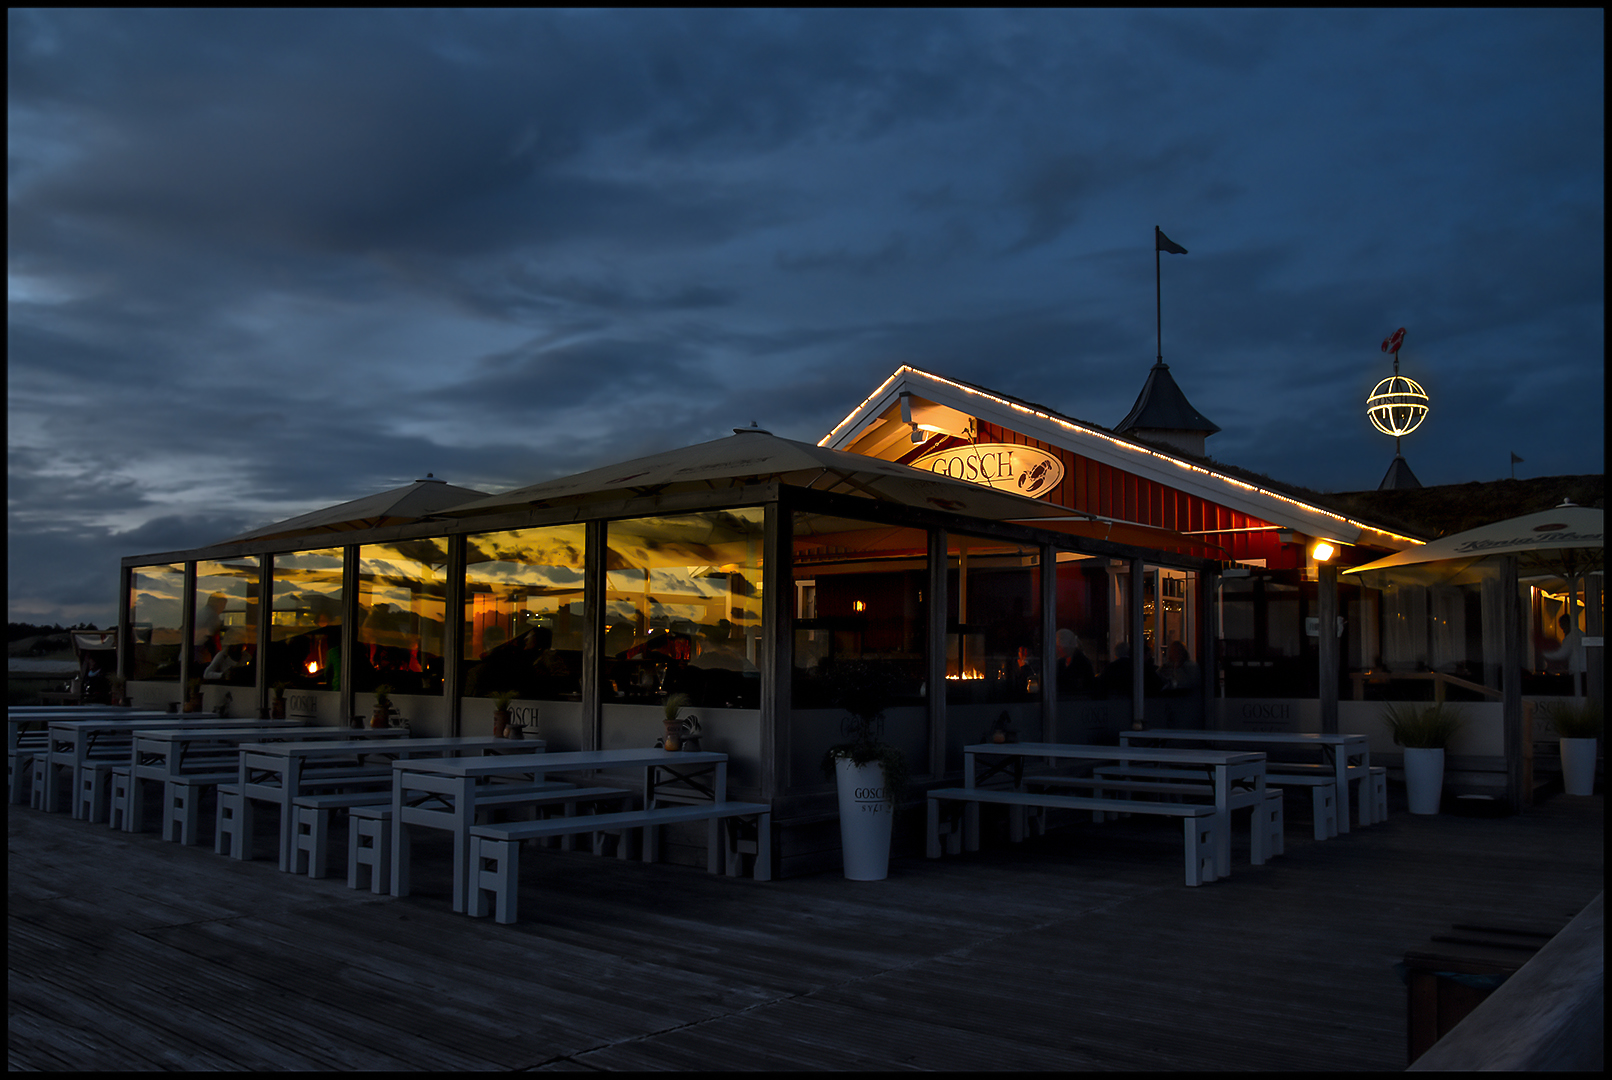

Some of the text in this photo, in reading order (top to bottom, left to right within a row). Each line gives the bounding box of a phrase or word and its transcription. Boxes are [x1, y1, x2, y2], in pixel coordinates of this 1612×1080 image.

[932, 451, 1014, 481] GOSCH
[291, 695, 318, 712] GOSCH
[1242, 703, 1290, 719] GOSCH
[508, 706, 540, 727] OSCH
